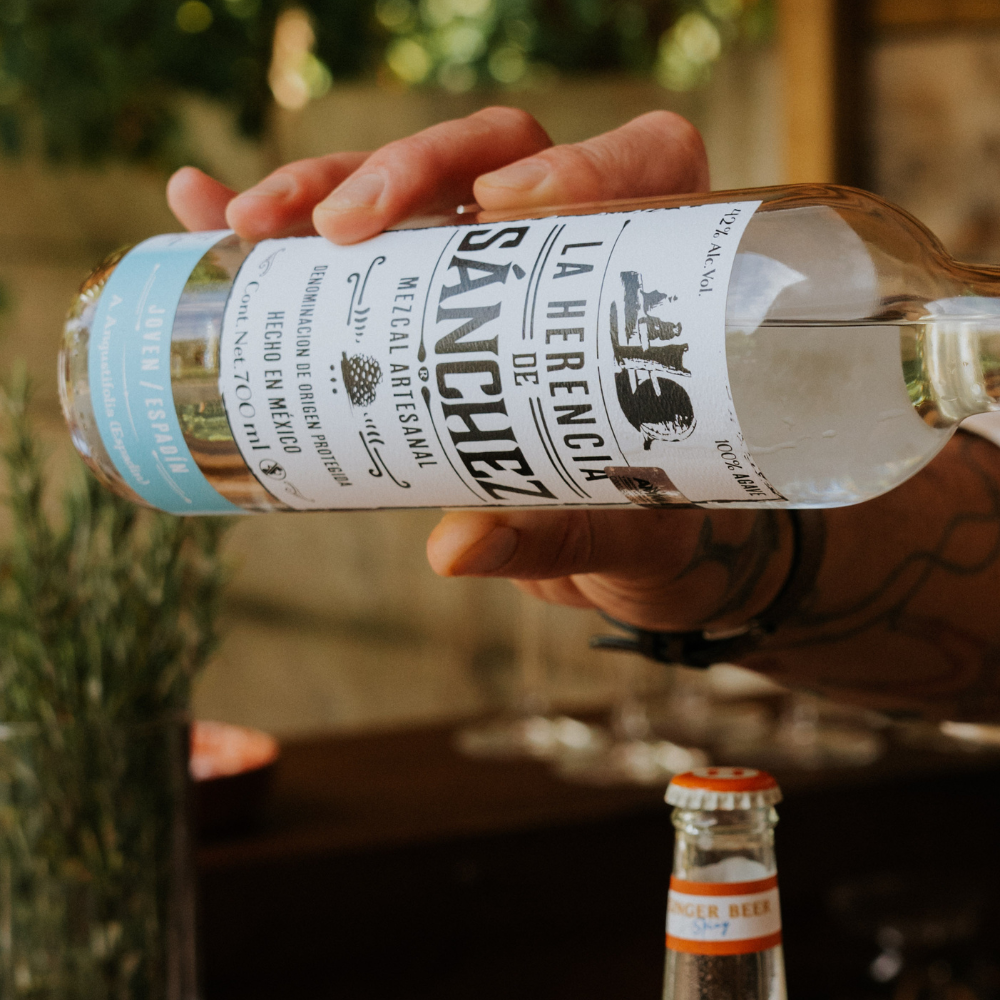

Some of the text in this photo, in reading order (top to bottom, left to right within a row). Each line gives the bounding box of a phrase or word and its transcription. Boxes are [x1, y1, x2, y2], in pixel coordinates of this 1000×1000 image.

[712, 208, 742, 239] 42%
[141, 303, 167, 372] JOVEN
[235, 281, 260, 328] Cont.
[263, 310, 302, 455] HECHO EN MÉXICO
[295, 264, 353, 488] DENOMINACION DE ORIGEN PROTEGIDA
[388, 275, 438, 469] MEZCAL ARTESANAL
[434, 225, 559, 500] SÁNCHEZ
[511, 352, 540, 387] DE
[544, 240, 612, 482] LA HERENCIA
[146, 395, 190, 475] ESPADÍN
[243, 423, 271, 451] ml
[714, 438, 767, 497] 100% AGAVE
[728, 900, 772, 919] BEER
